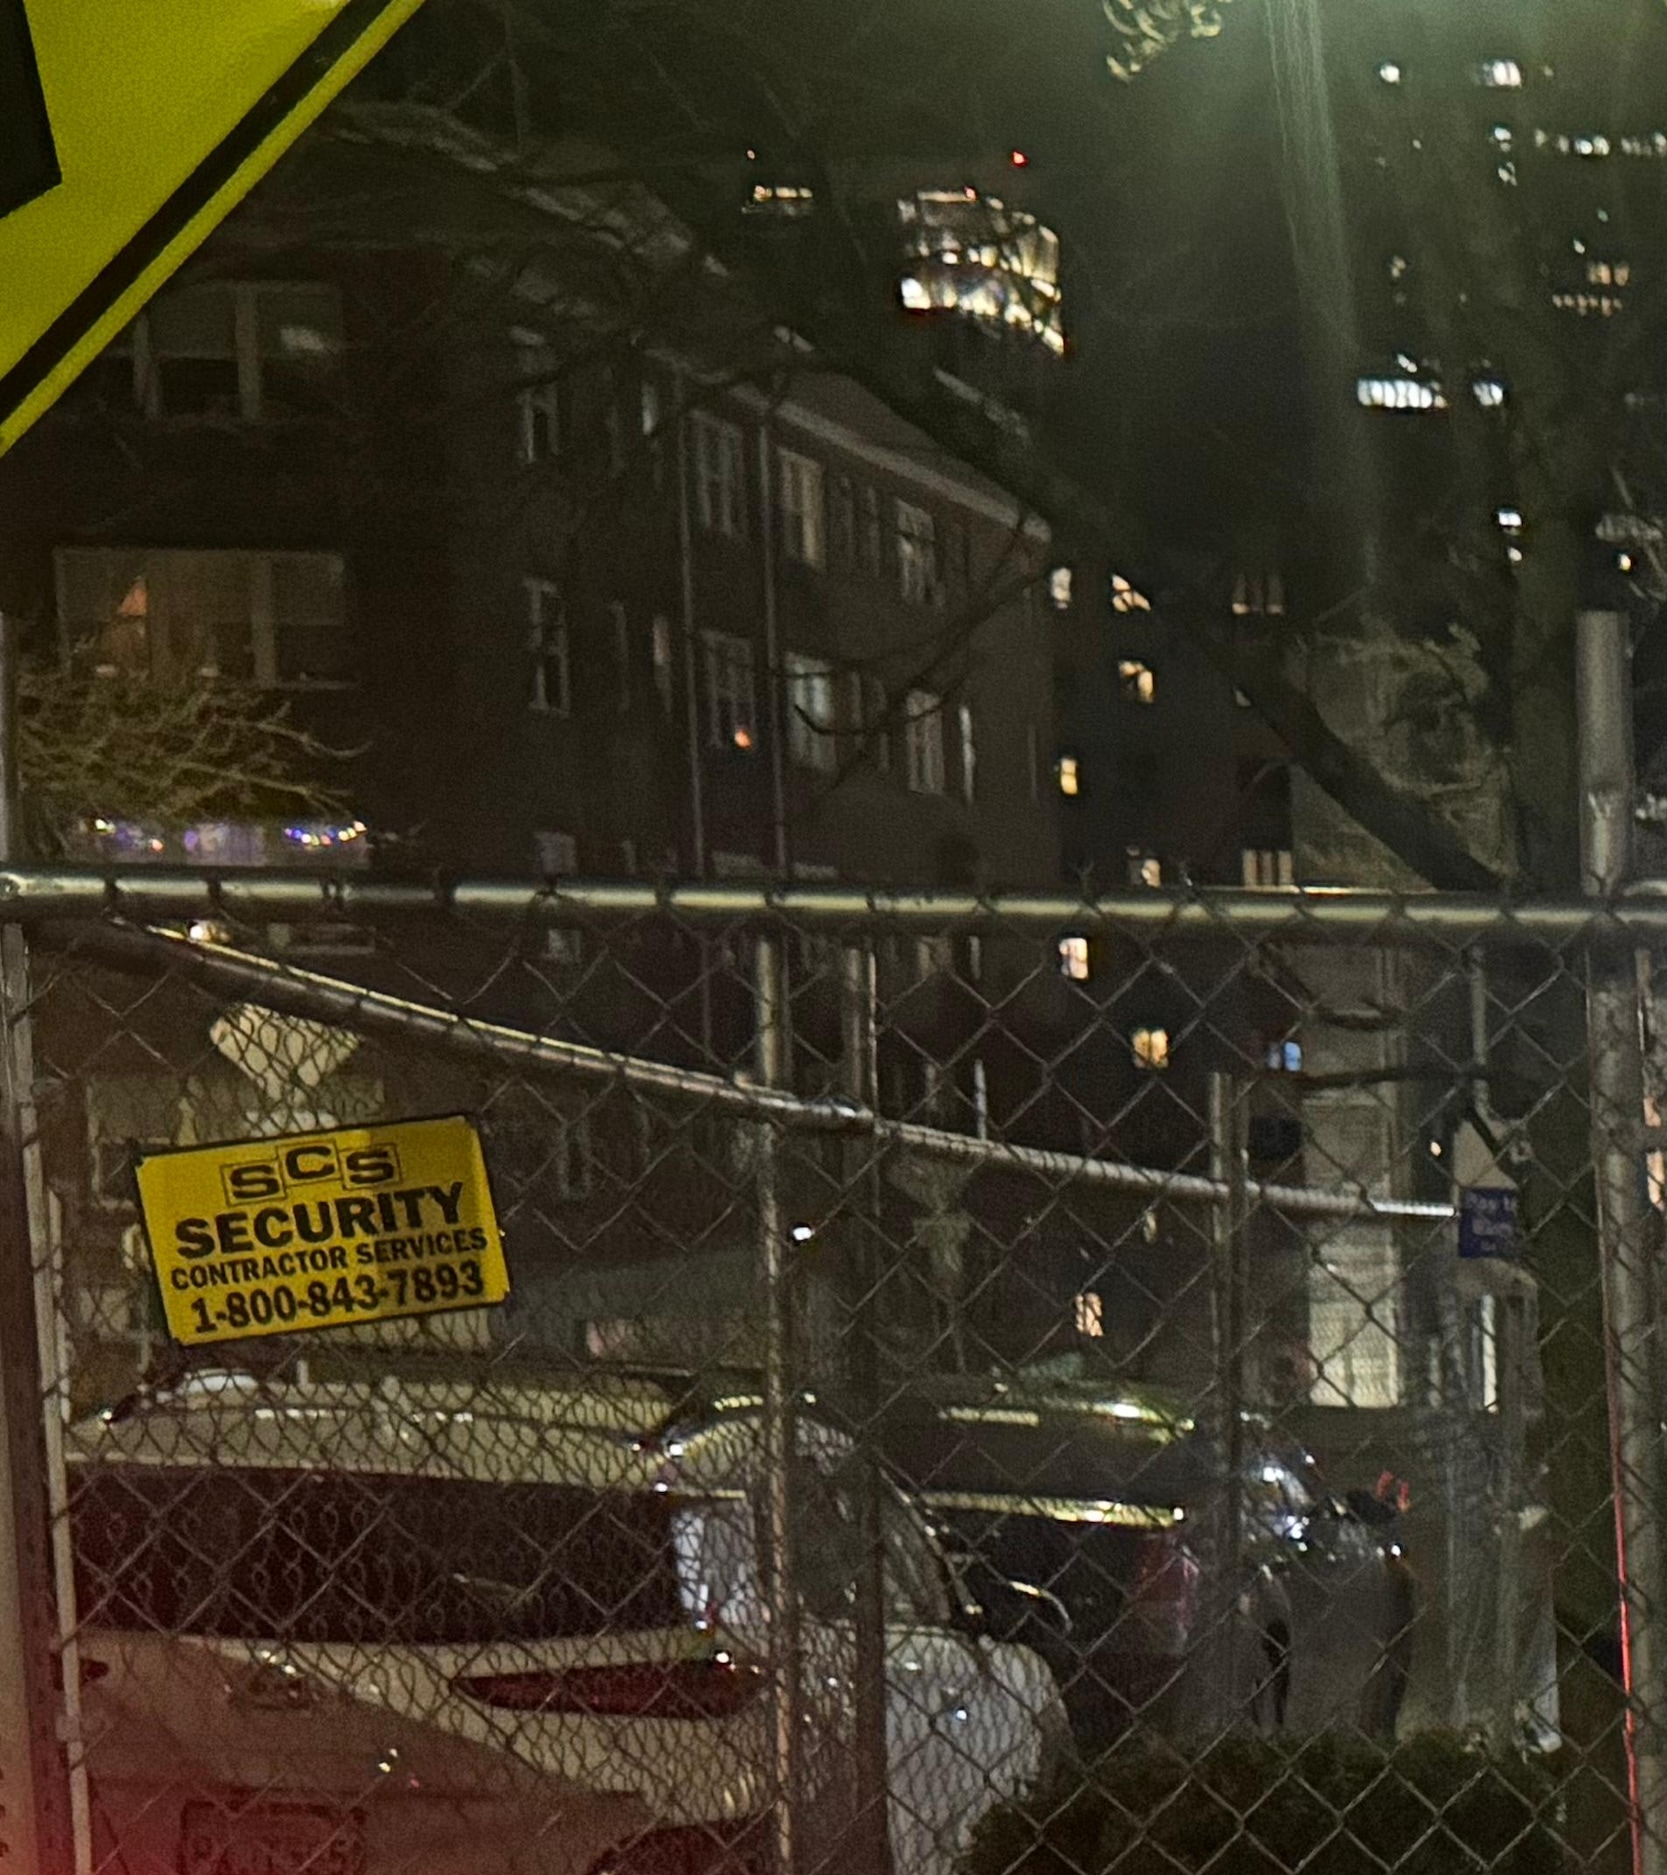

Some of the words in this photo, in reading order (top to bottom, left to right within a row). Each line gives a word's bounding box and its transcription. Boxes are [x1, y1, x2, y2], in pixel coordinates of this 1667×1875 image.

[229, 1145, 394, 1200] SCS
[175, 1181, 463, 1259] SECURITY
[171, 1245, 349, 1291] CONTRACTOR
[357, 1227, 488, 1266] SERVICES
[190, 1259, 484, 1334] 1-800-843-7893
